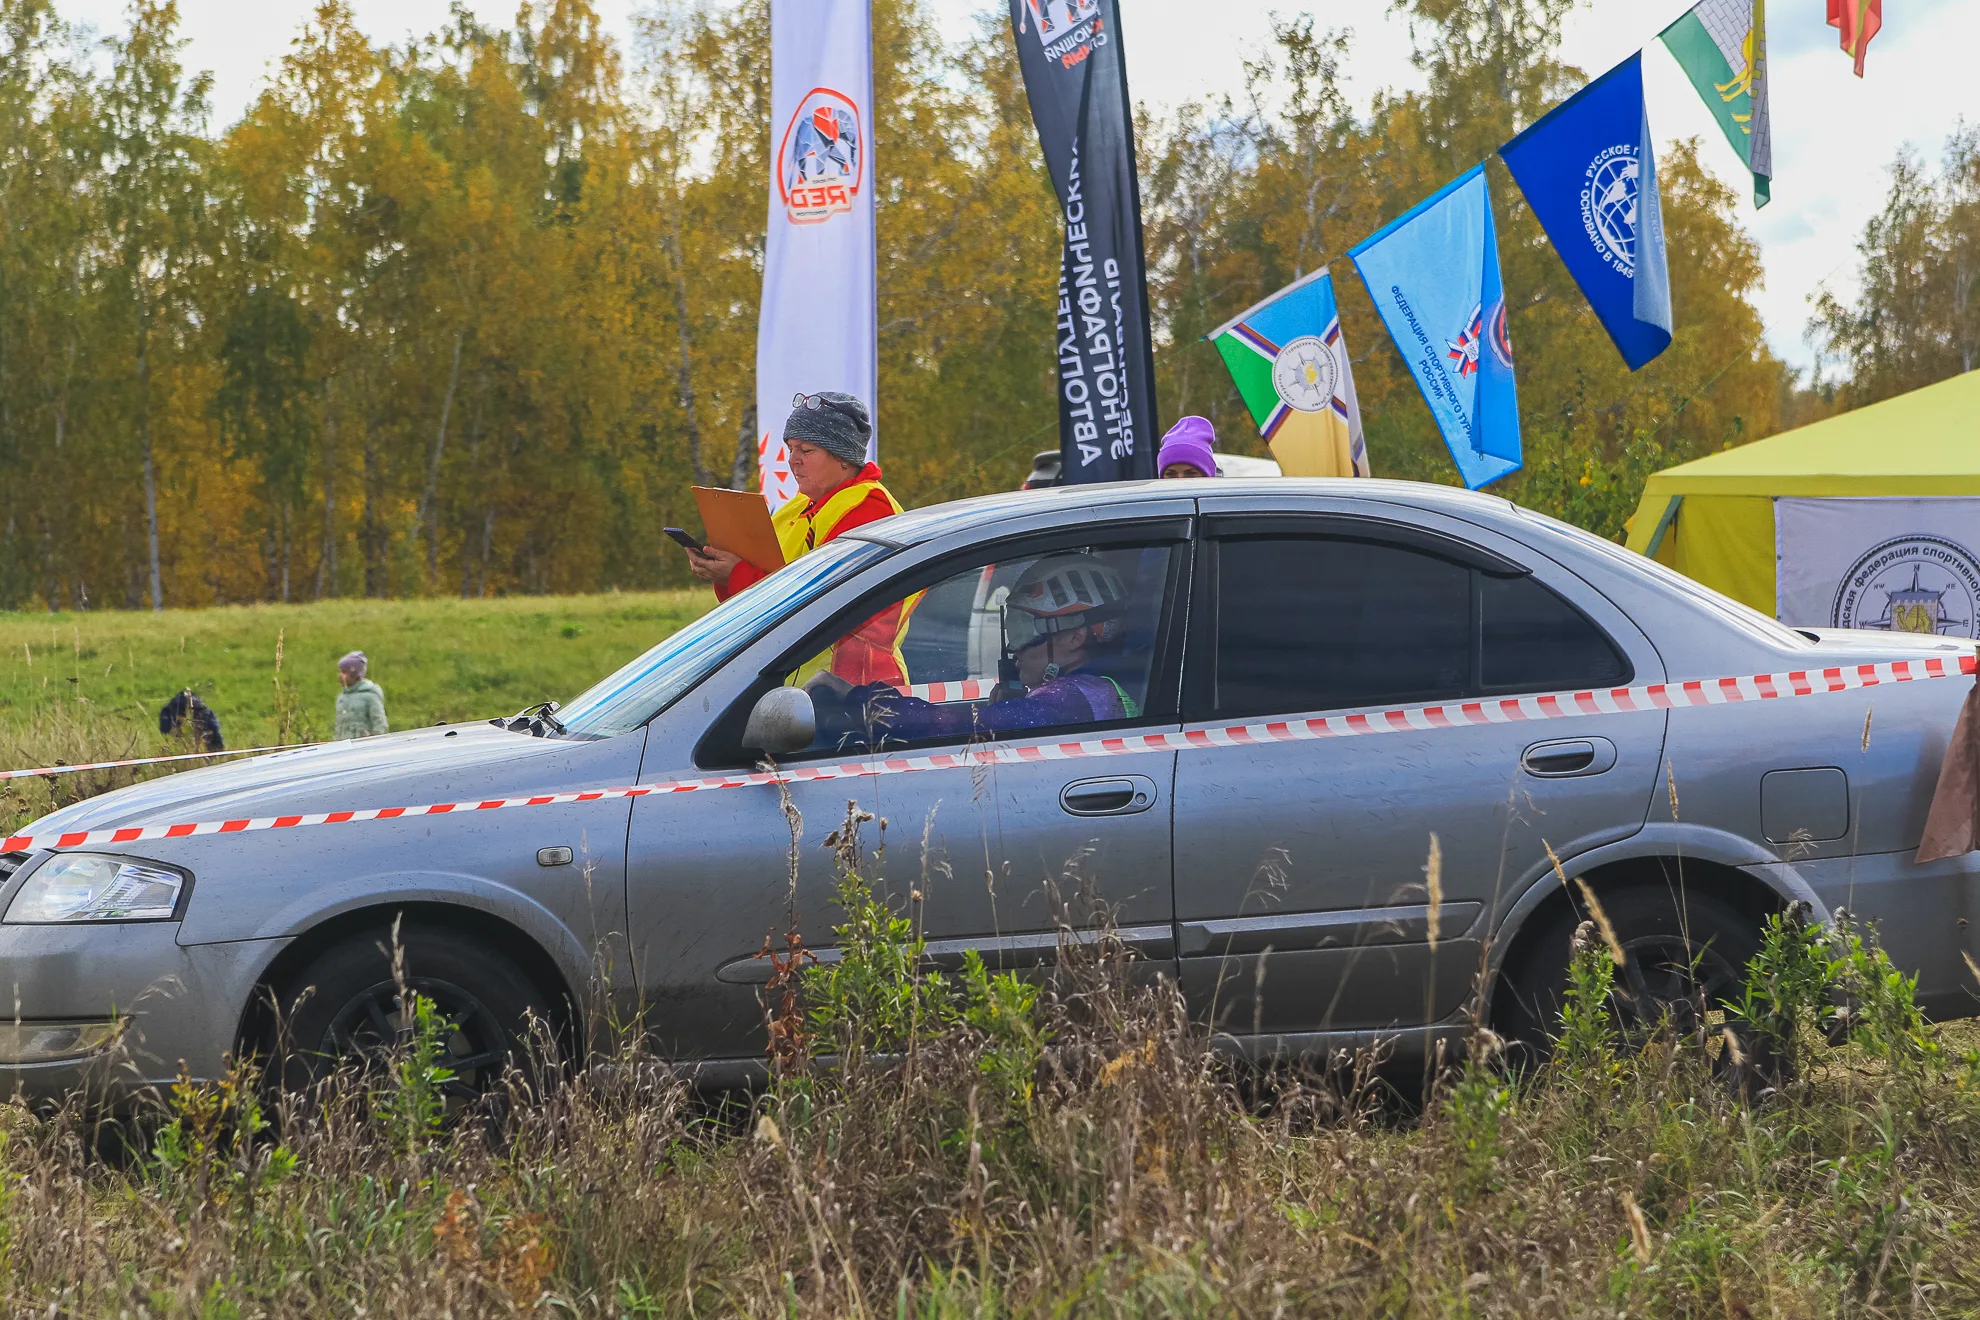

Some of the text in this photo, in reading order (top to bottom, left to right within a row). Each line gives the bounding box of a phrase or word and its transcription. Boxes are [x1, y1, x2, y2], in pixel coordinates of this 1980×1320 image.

[1586, 145, 1631, 178] РУССКОЕ
[1580, 189, 1634, 279] ОСНОВАНО В 1845
[1391, 285, 1429, 347] ФЕДЕРАЦИЯ
[1424, 343, 1462, 414] СПОРТИВНОГО
[1418, 359, 1444, 400] РОССИИ
[1854, 546, 1919, 589] федерация
[1913, 563, 1920, 572] N
